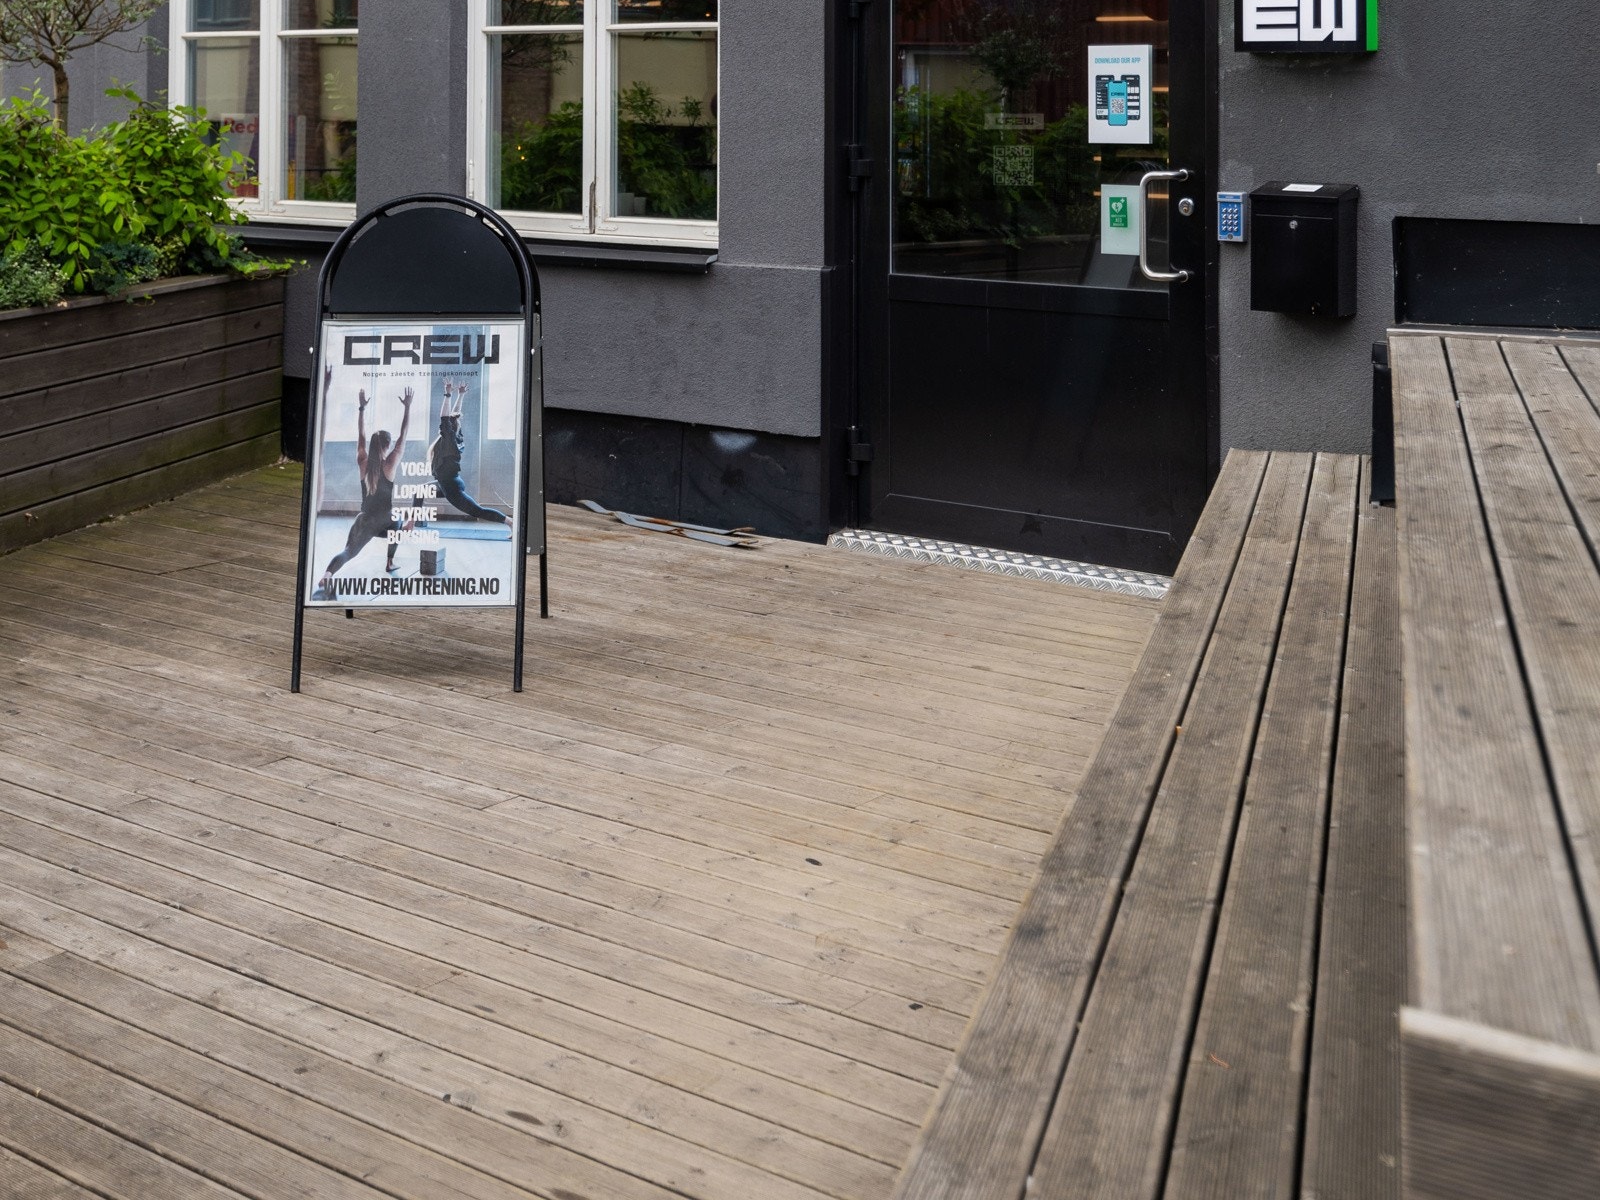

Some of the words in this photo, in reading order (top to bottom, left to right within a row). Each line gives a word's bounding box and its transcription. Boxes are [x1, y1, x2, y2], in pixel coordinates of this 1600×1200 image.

[343, 334, 500, 366] CREW
[419, 370, 480, 378] treningskonsept
[400, 461, 433, 477] YOGA
[391, 506, 438, 522] STYRKE
[387, 529, 440, 545] BOKSING
[324, 577, 500, 596] WWW.CREWTRENING.NO
